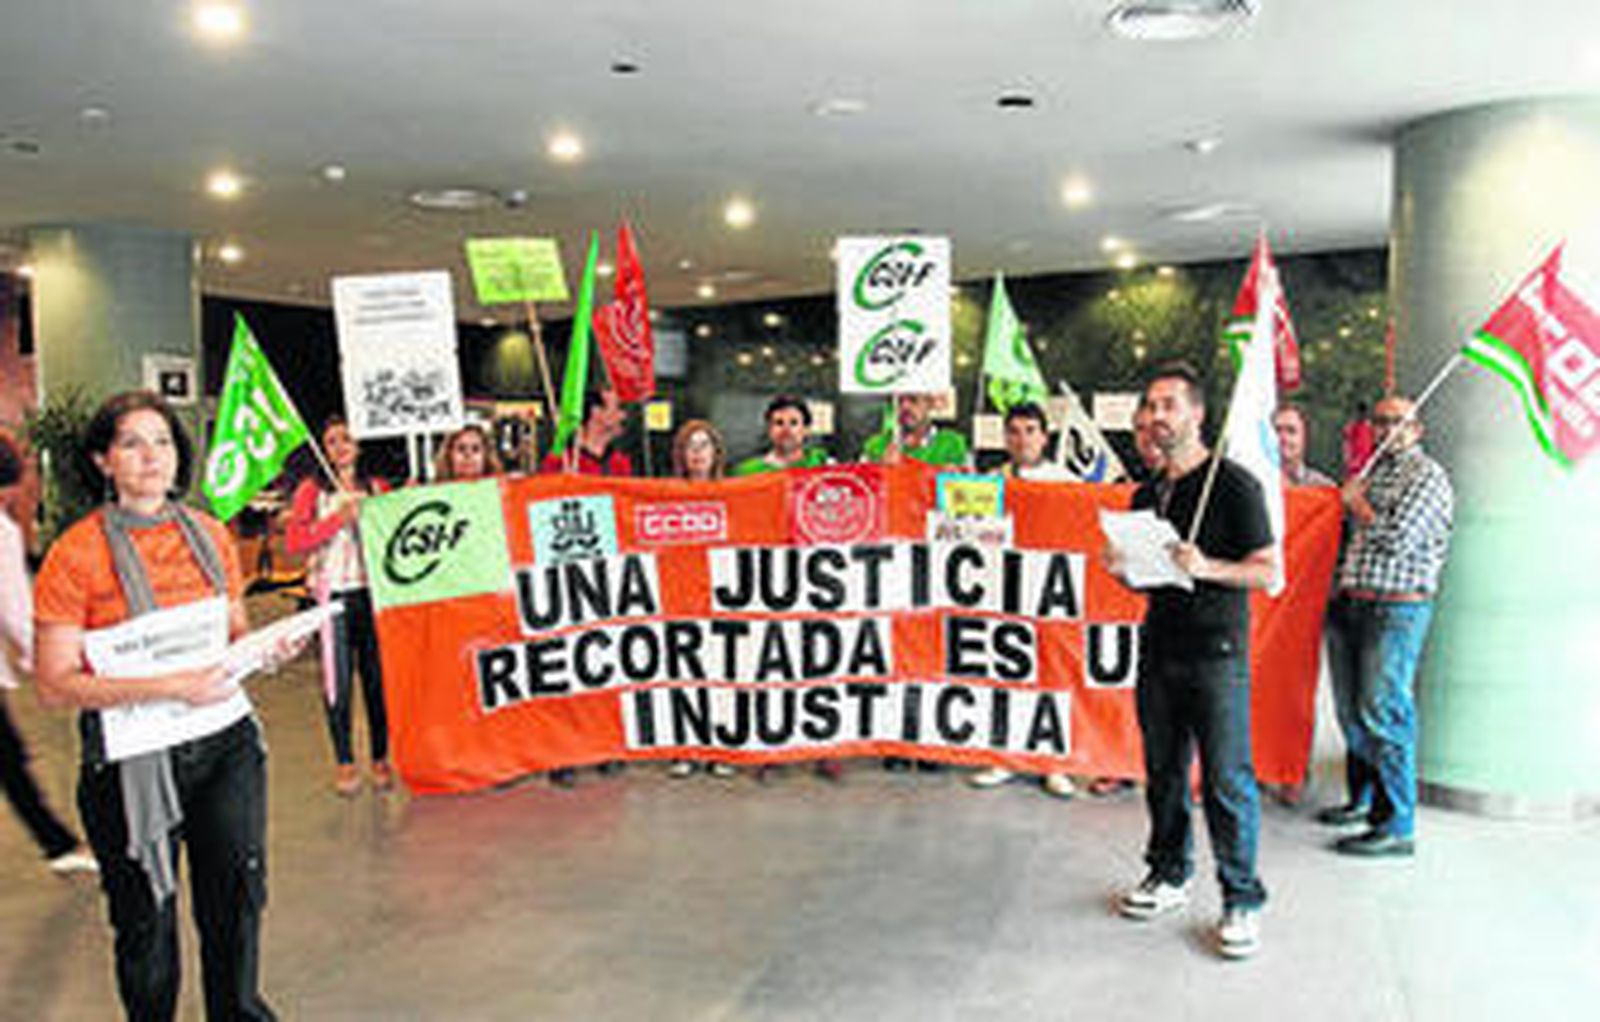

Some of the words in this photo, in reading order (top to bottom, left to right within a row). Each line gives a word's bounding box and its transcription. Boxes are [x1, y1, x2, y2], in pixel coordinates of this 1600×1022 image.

[644, 513, 718, 535] CCOO
[516, 554, 656, 631] UNA
[714, 544, 1078, 618] JUSTICIA
[478, 619, 888, 708] RECORTADA
[947, 618, 1033, 680] ES
[1087, 623, 1144, 685] U
[635, 685, 1068, 754] INJUSTICIA
